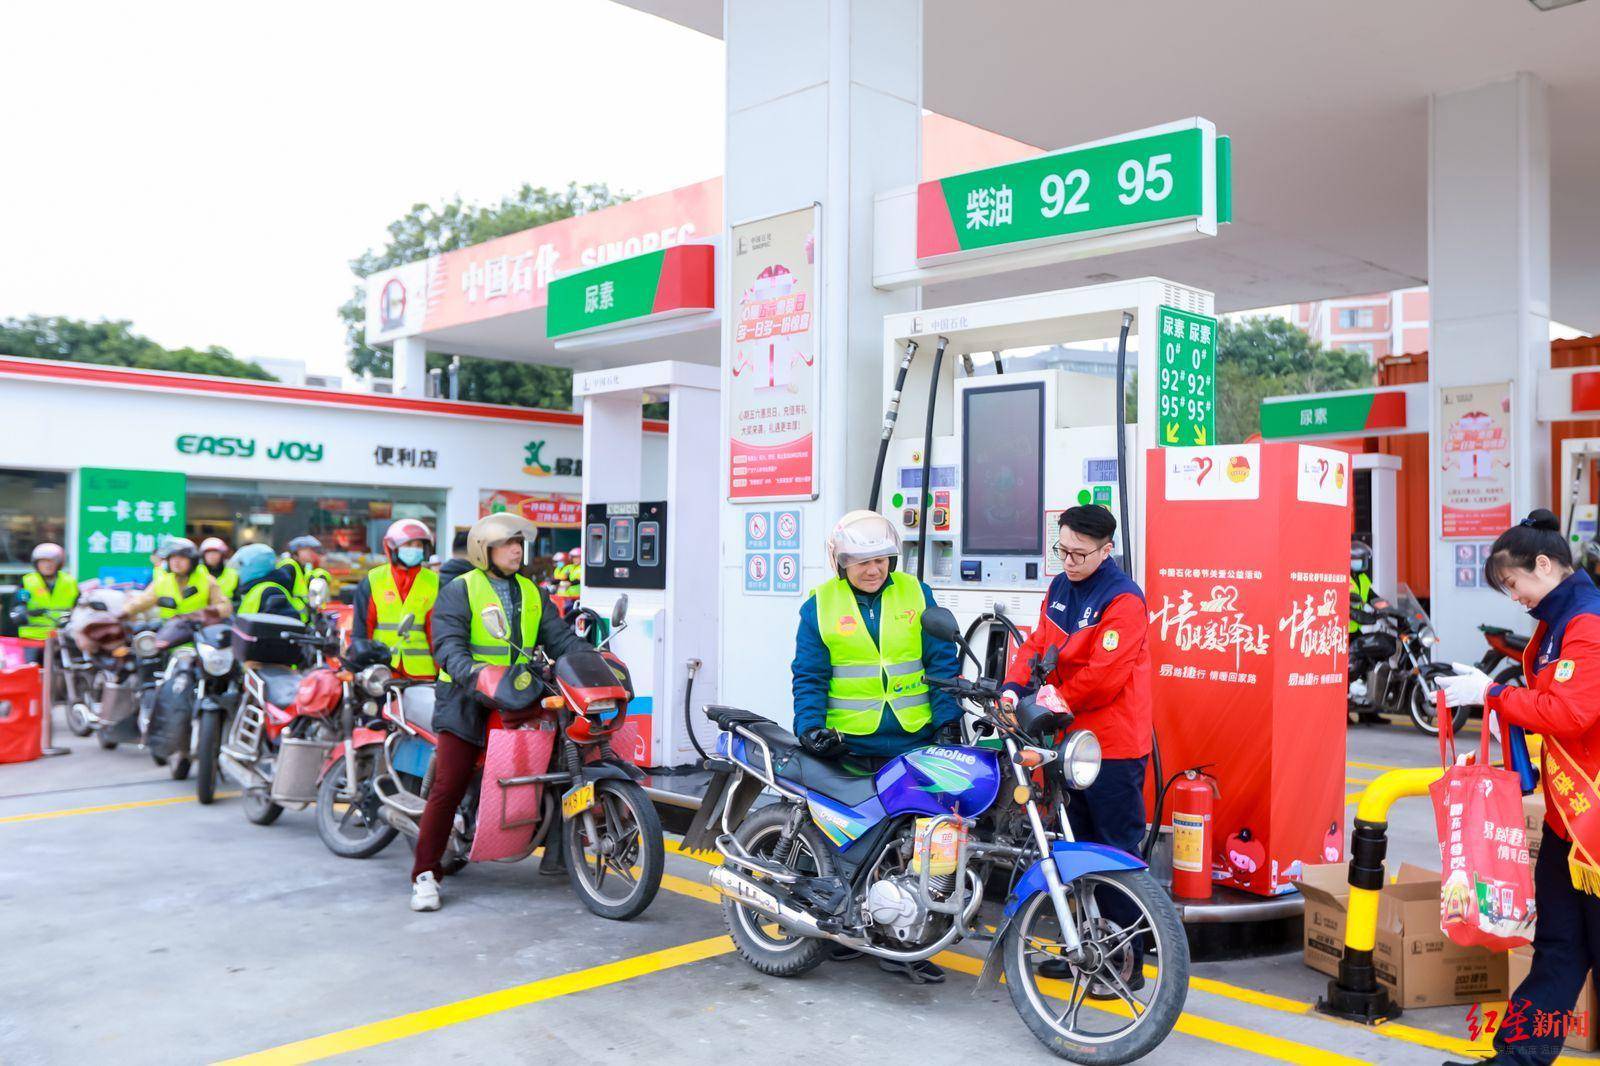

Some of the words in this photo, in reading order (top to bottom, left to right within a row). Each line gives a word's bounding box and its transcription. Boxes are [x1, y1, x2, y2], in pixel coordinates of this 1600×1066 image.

[966, 185, 1013, 230] 柴油
[1040, 169, 1090, 218] 92
[1117, 154, 1174, 206] 95
[462, 244, 560, 302] 中国石化
[584, 281, 615, 314] 尿素
[1163, 316, 1185, 339] 尿素
[1189, 322, 1211, 345] 尿素
[1166, 343, 1181, 364] 0#
[1192, 349, 1207, 370] 0#
[1161, 368, 1185, 392] 92#
[1188, 374, 1212, 397] 92#
[1161, 394, 1185, 418] 95#
[1188, 400, 1212, 423] 95#
[1300, 408, 1327, 425] 尿素
[176, 434, 255, 457] EASY
[266, 441, 323, 461] JOY
[374, 445, 437, 469] 便利店
[87, 499, 177, 524] 一卡在手
[783, 561, 791, 576] 5
[1159, 568, 1263, 580] 中国石化春节关爱公益活动
[1149, 589, 1270, 673] 情暖驿站
[1278, 594, 1347, 674] 情暖驿站
[1209, 670, 1257, 684] 情暖回家路
